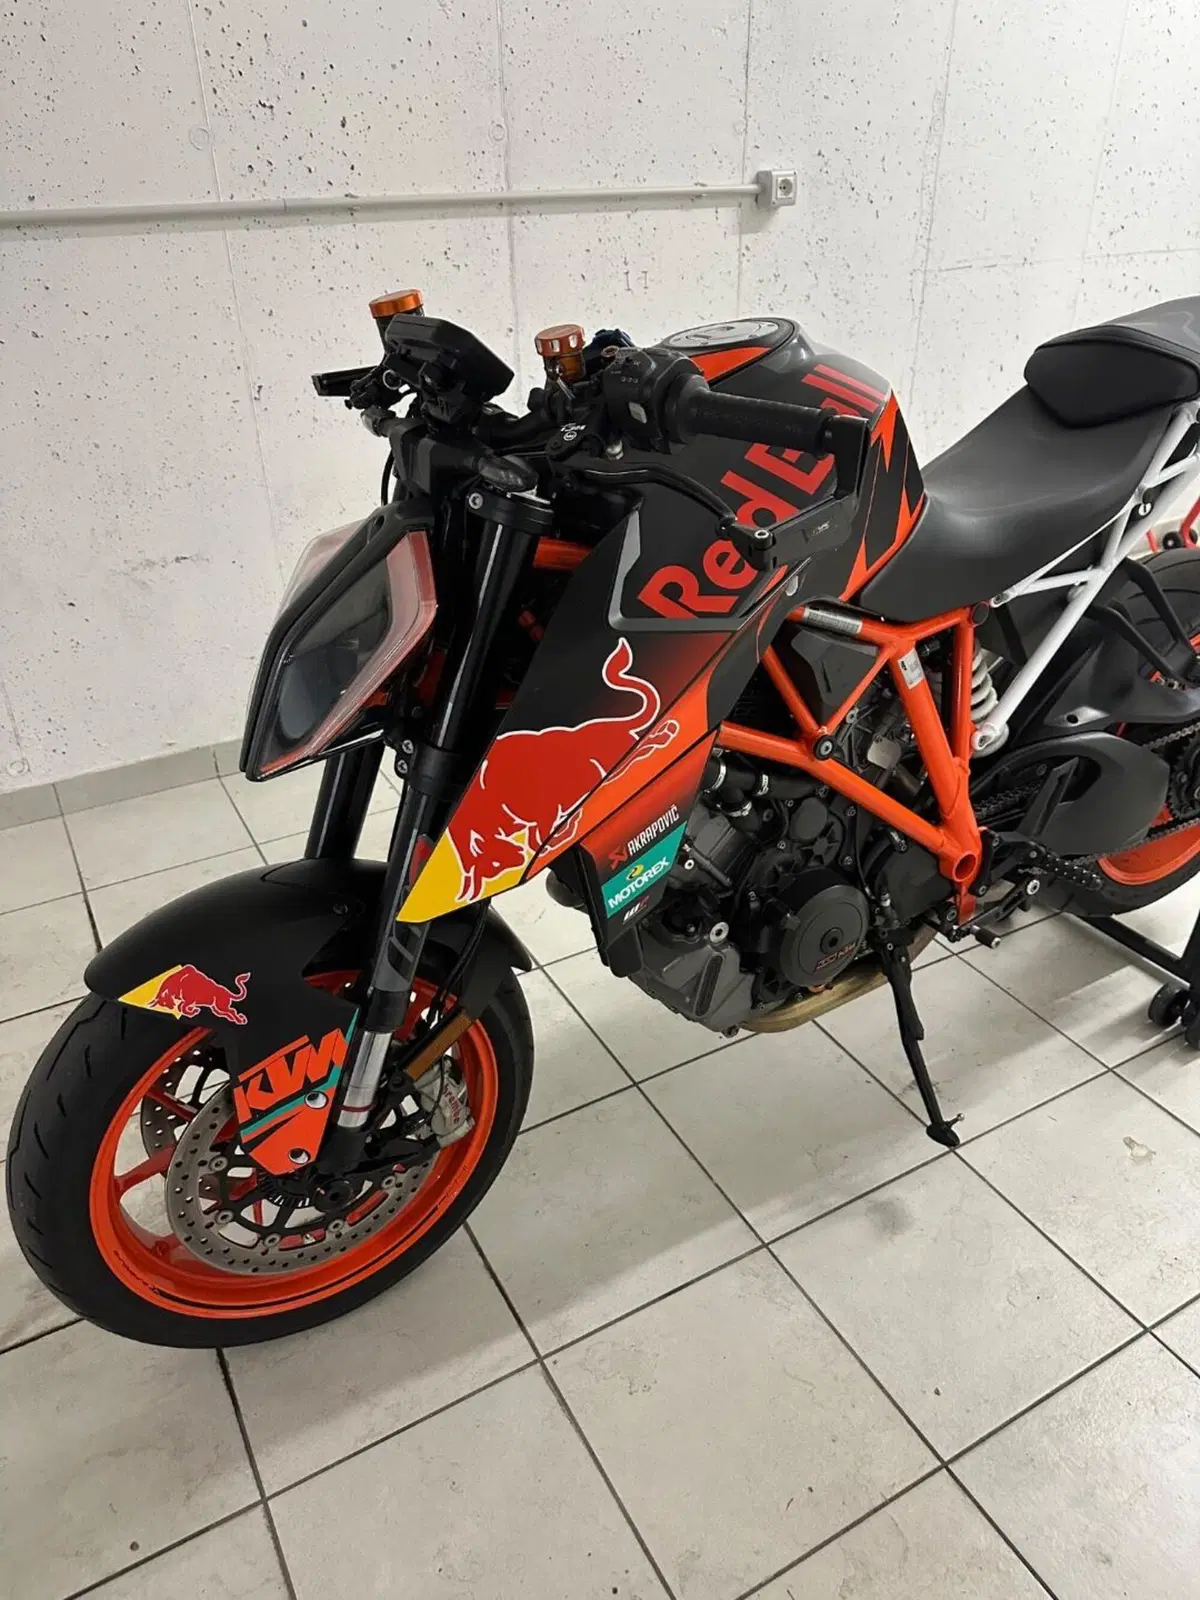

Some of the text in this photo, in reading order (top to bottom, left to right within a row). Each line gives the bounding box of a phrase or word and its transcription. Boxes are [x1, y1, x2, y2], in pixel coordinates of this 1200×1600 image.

[637, 470, 800, 618] Red
[607, 856, 670, 909] MOTOREX
[233, 1028, 350, 1124] KTM
